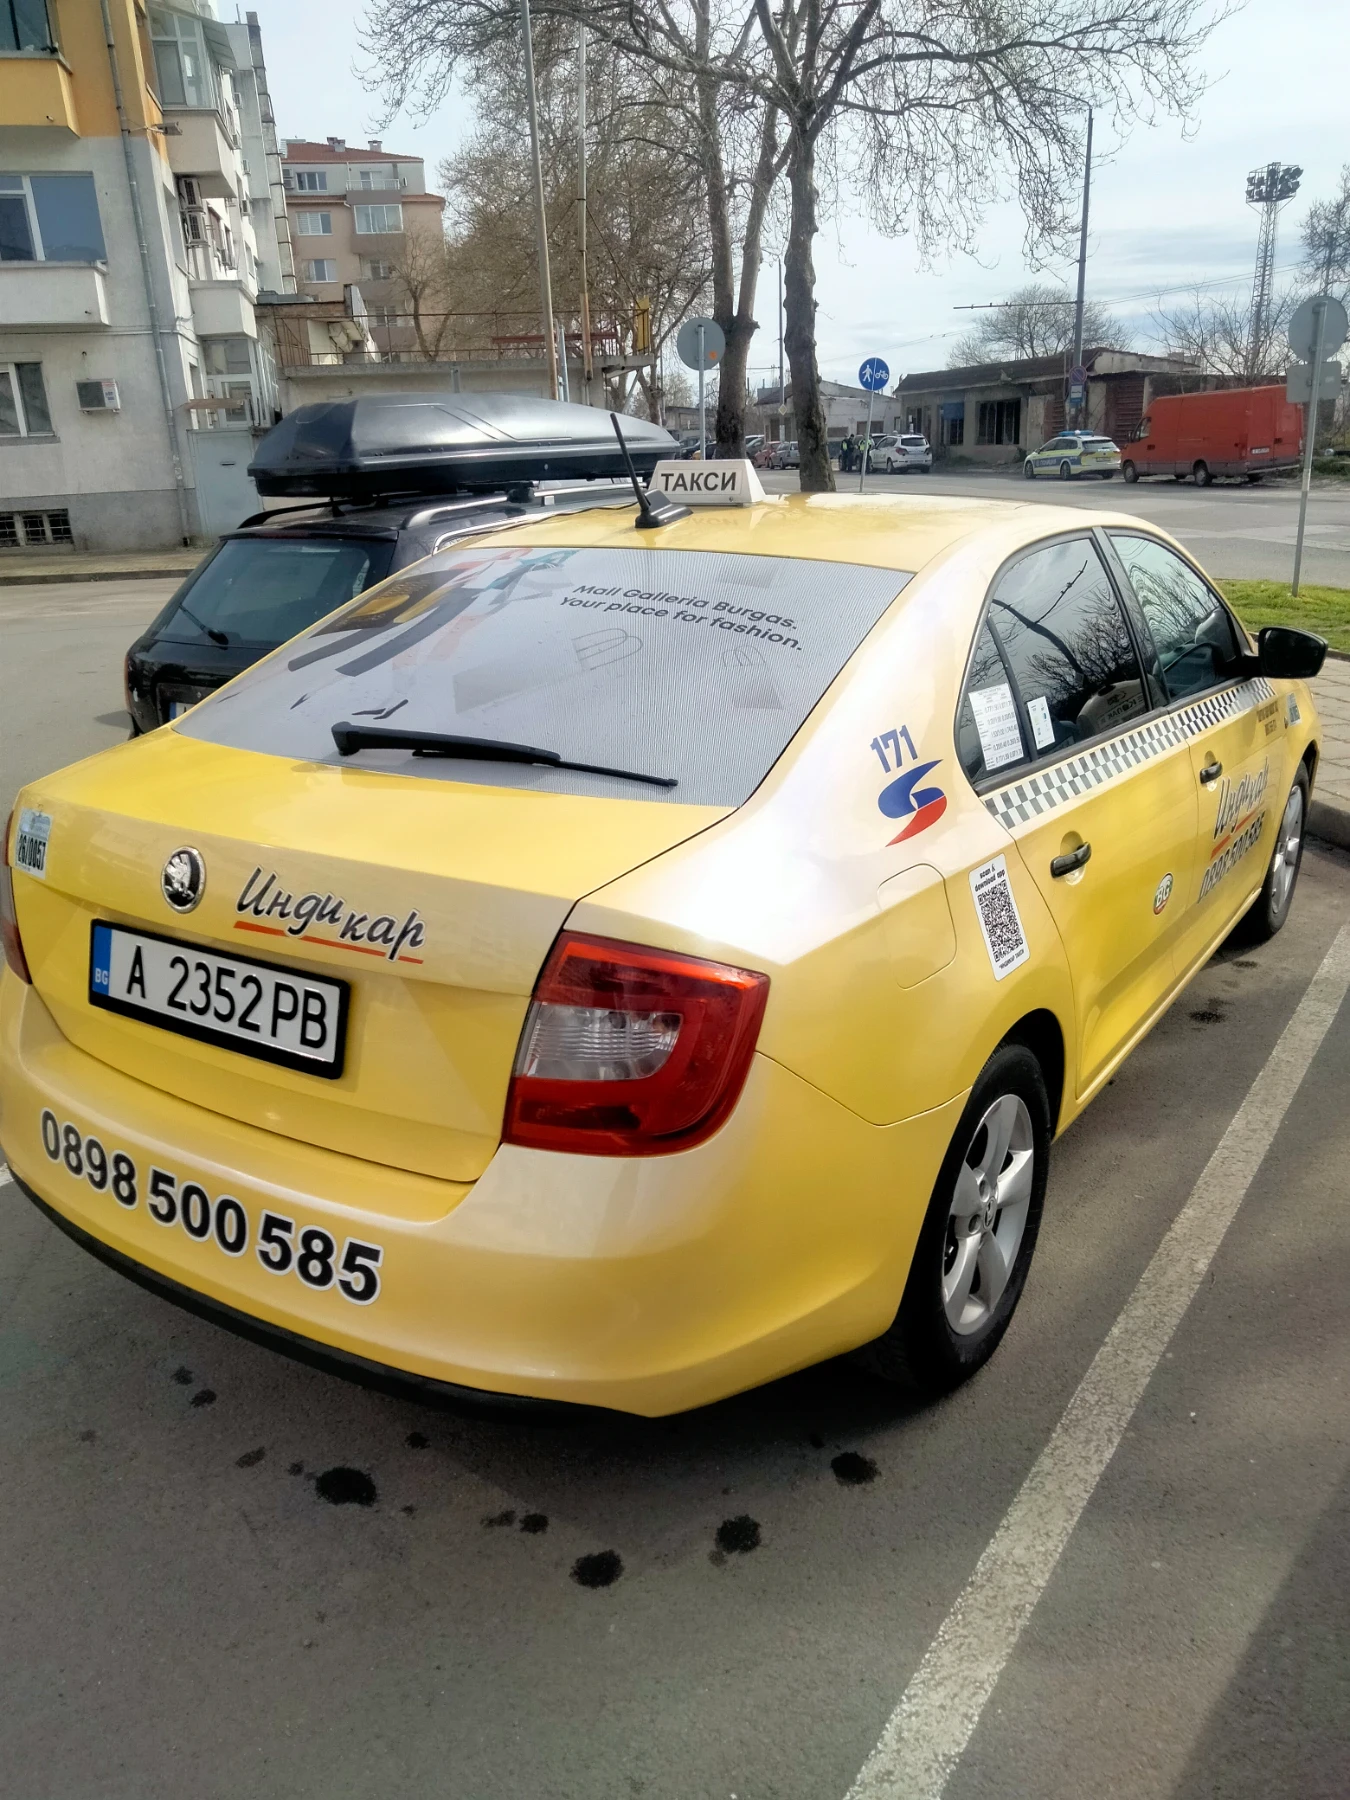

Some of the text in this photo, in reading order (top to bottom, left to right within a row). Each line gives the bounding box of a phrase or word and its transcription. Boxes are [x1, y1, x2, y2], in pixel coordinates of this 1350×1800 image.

[661, 471, 737, 492] ТАКСИ
[560, 596, 803, 651] Your place for fashion.
[572, 585, 797, 630] Mall Galleria Burgas.
[870, 724, 919, 774] 171
[974, 869, 1006, 892] download app
[979, 867, 991, 880] scan
[1155, 879, 1172, 907] BG
[237, 867, 426, 962] Индикар
[94, 944, 328, 1050] BG A 2352 PB
[41, 1107, 383, 1306] 0898 500 585
